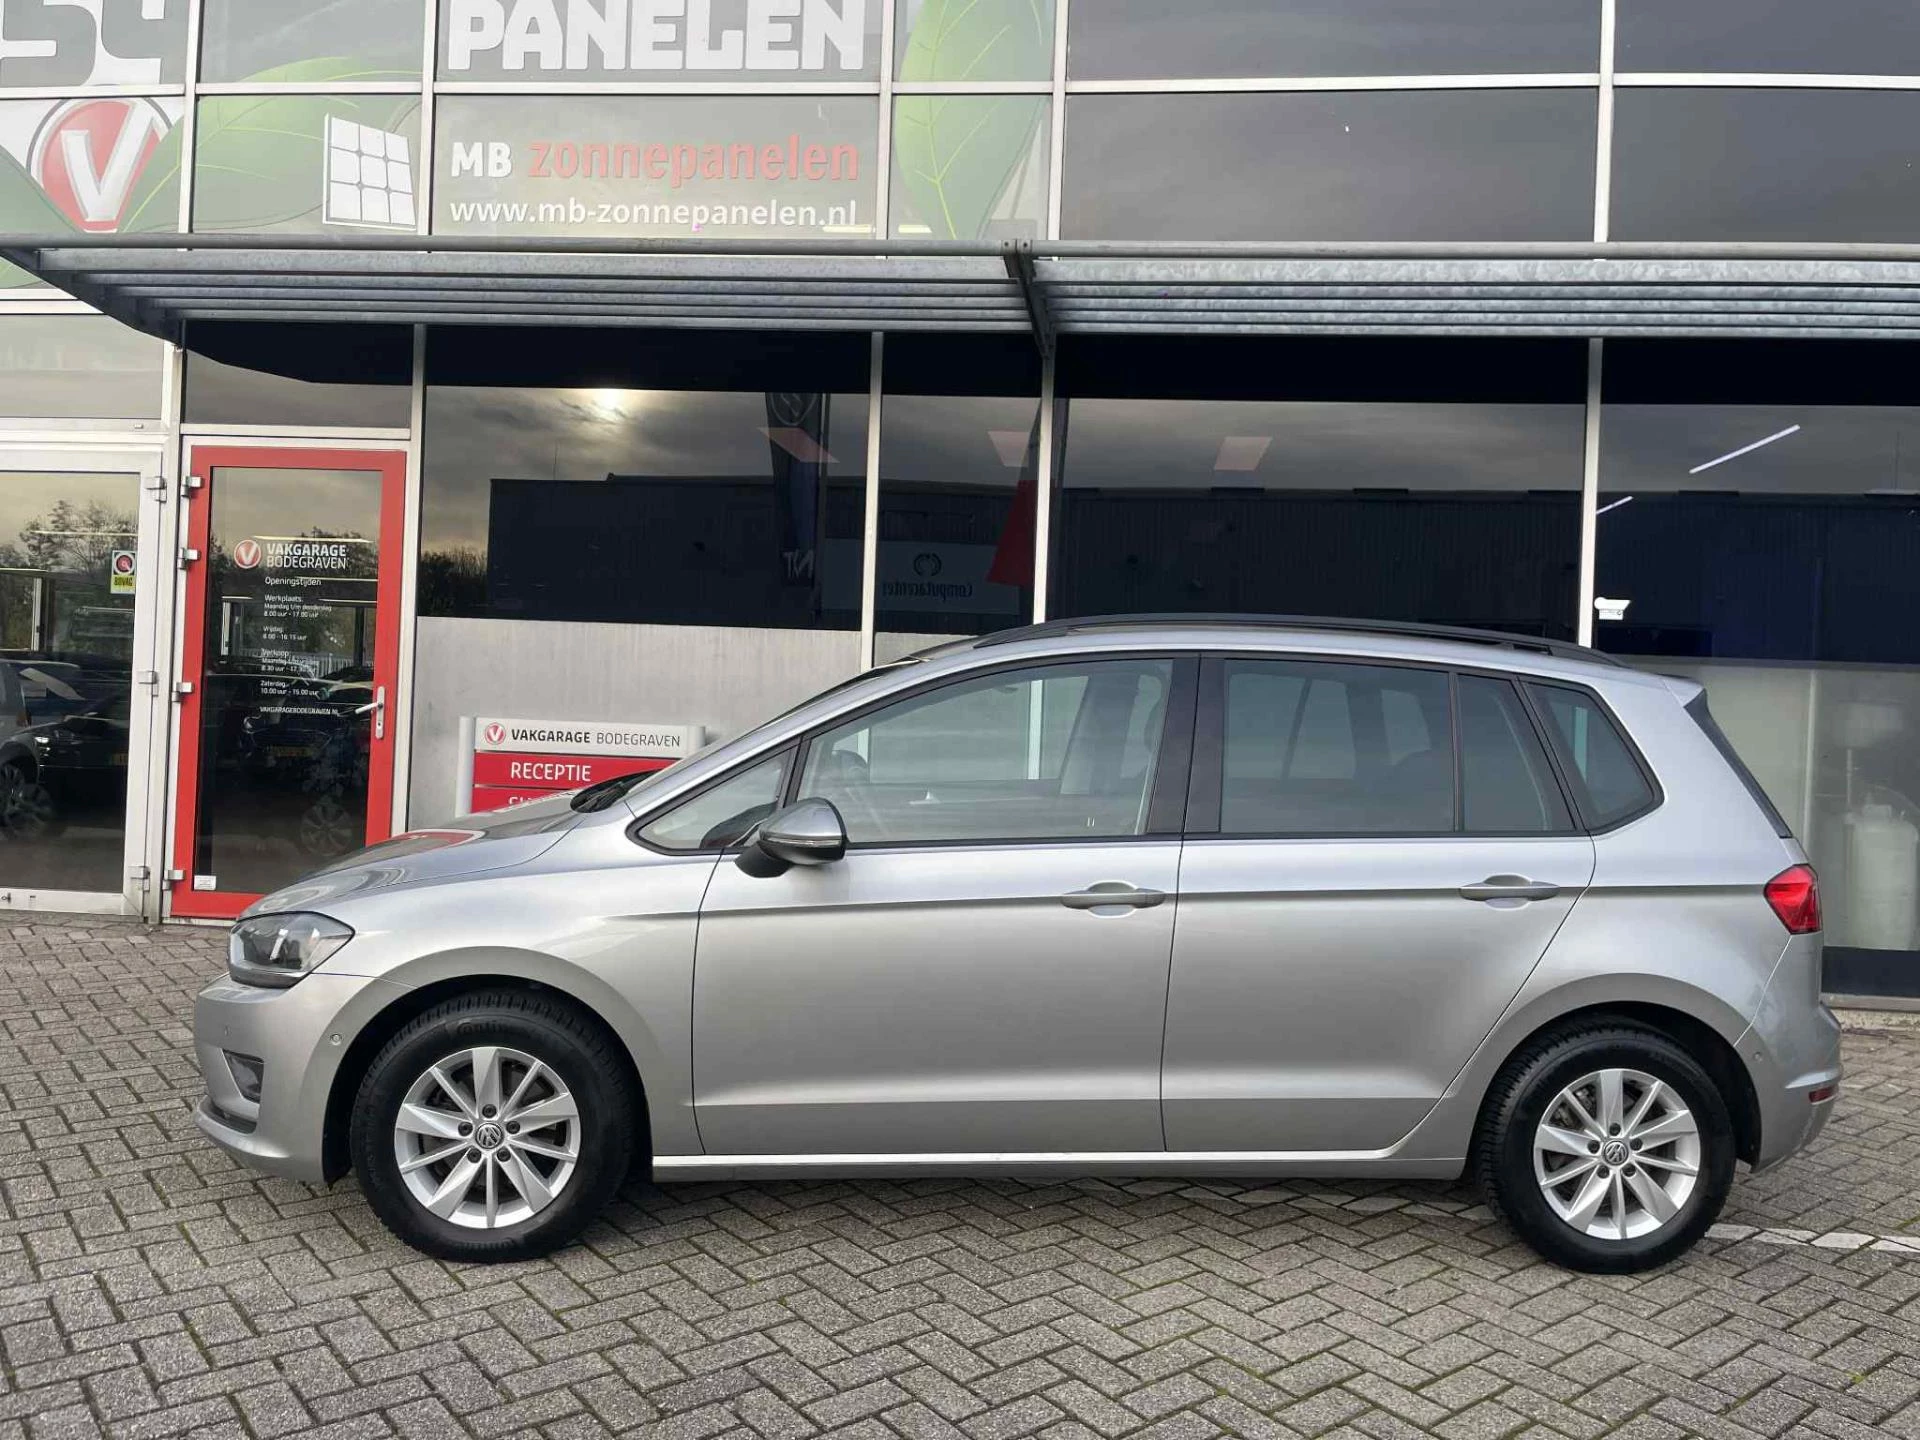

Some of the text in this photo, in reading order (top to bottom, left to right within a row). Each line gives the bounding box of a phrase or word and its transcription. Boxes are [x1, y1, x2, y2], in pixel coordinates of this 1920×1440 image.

[448, 0, 864, 70] PANELEN
[450, 134, 860, 190] MB zonnepanelen
[449, 198, 858, 234] www.mb-zonnepanelen.nl
[266, 543, 347, 557] VAKGARAGE
[266, 555, 346, 569] BODEGRAVEN
[265, 577, 322, 587] Openingstijden
[511, 728, 591, 744] VAKGARAGE
[596, 732, 681, 748] BODEGRAVEN
[510, 761, 592, 782] RECEPTIE
